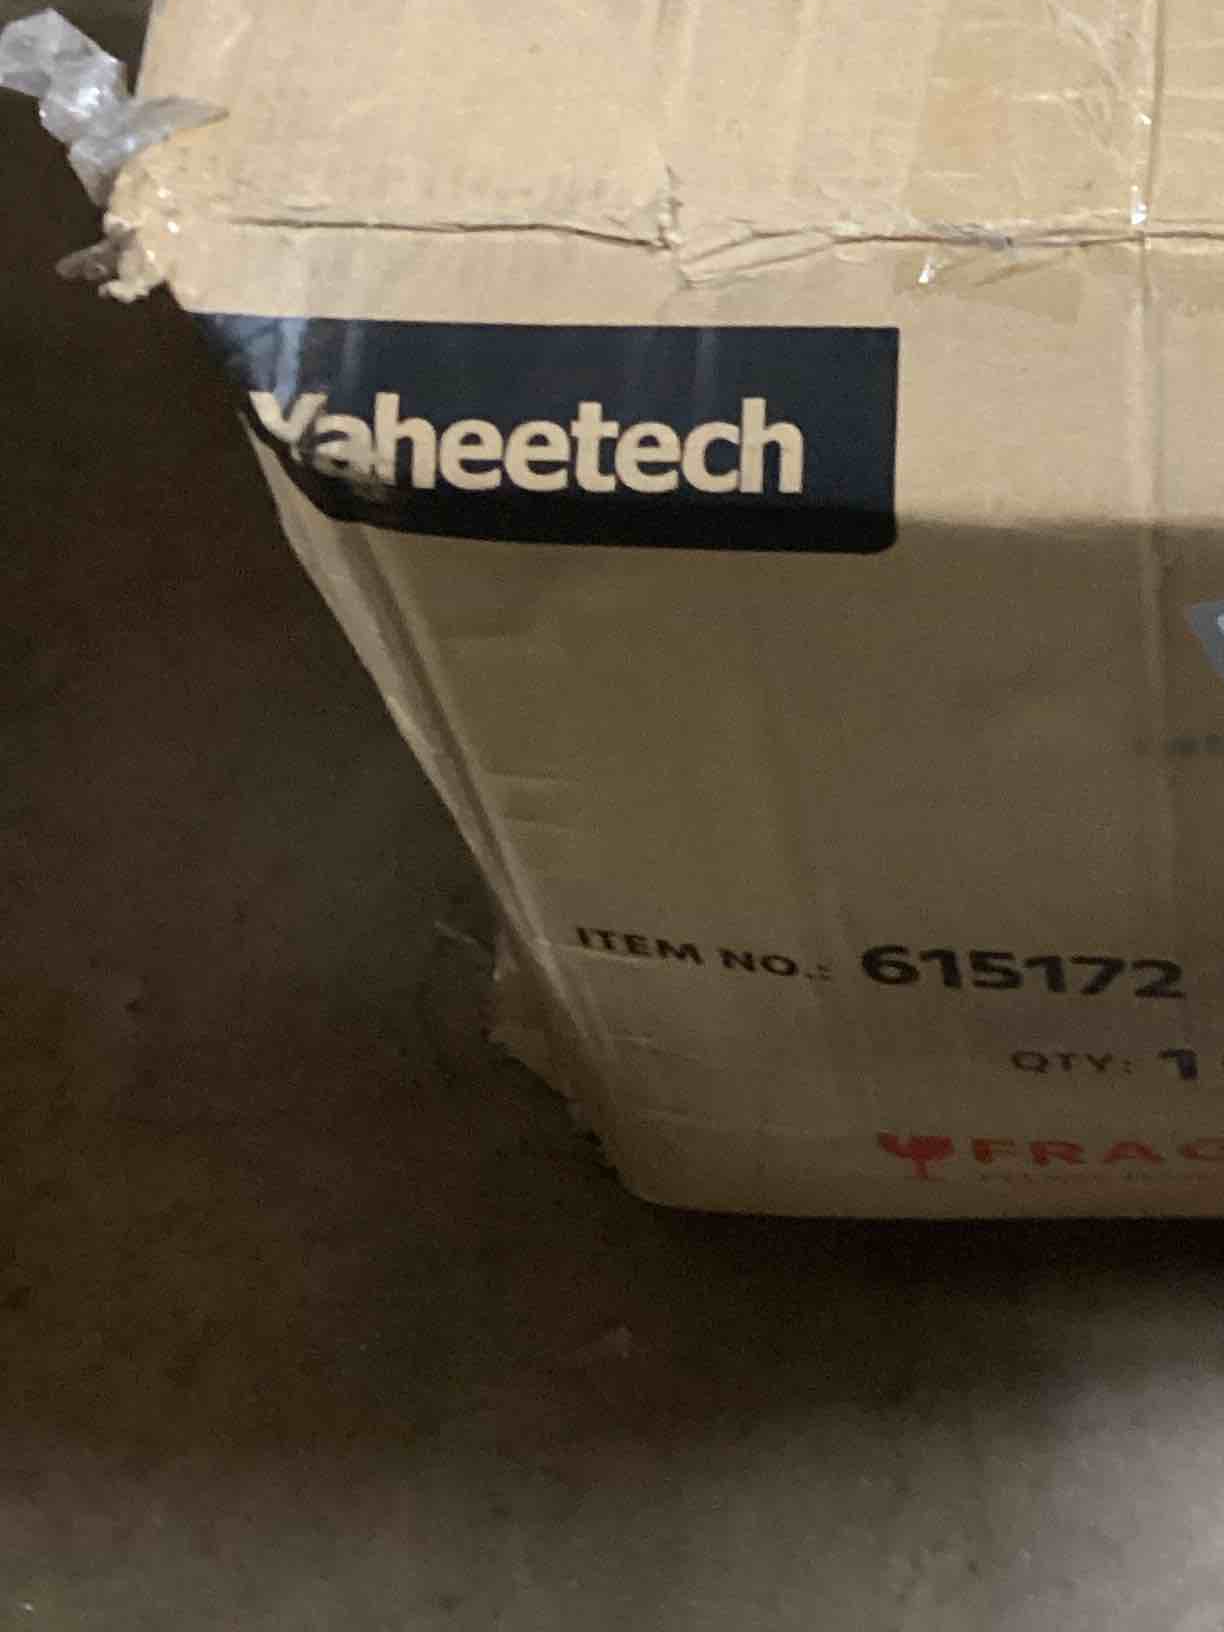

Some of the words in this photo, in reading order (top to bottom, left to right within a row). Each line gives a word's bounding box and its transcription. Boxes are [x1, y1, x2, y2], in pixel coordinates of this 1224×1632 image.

[250, 390, 805, 495] Yaheetech
[576, 925, 703, 964] ITEM
[861, 944, 1187, 1000] 615172
[1010, 1049, 1134, 1076] QTY:
[1156, 1048, 1200, 1081] 1
